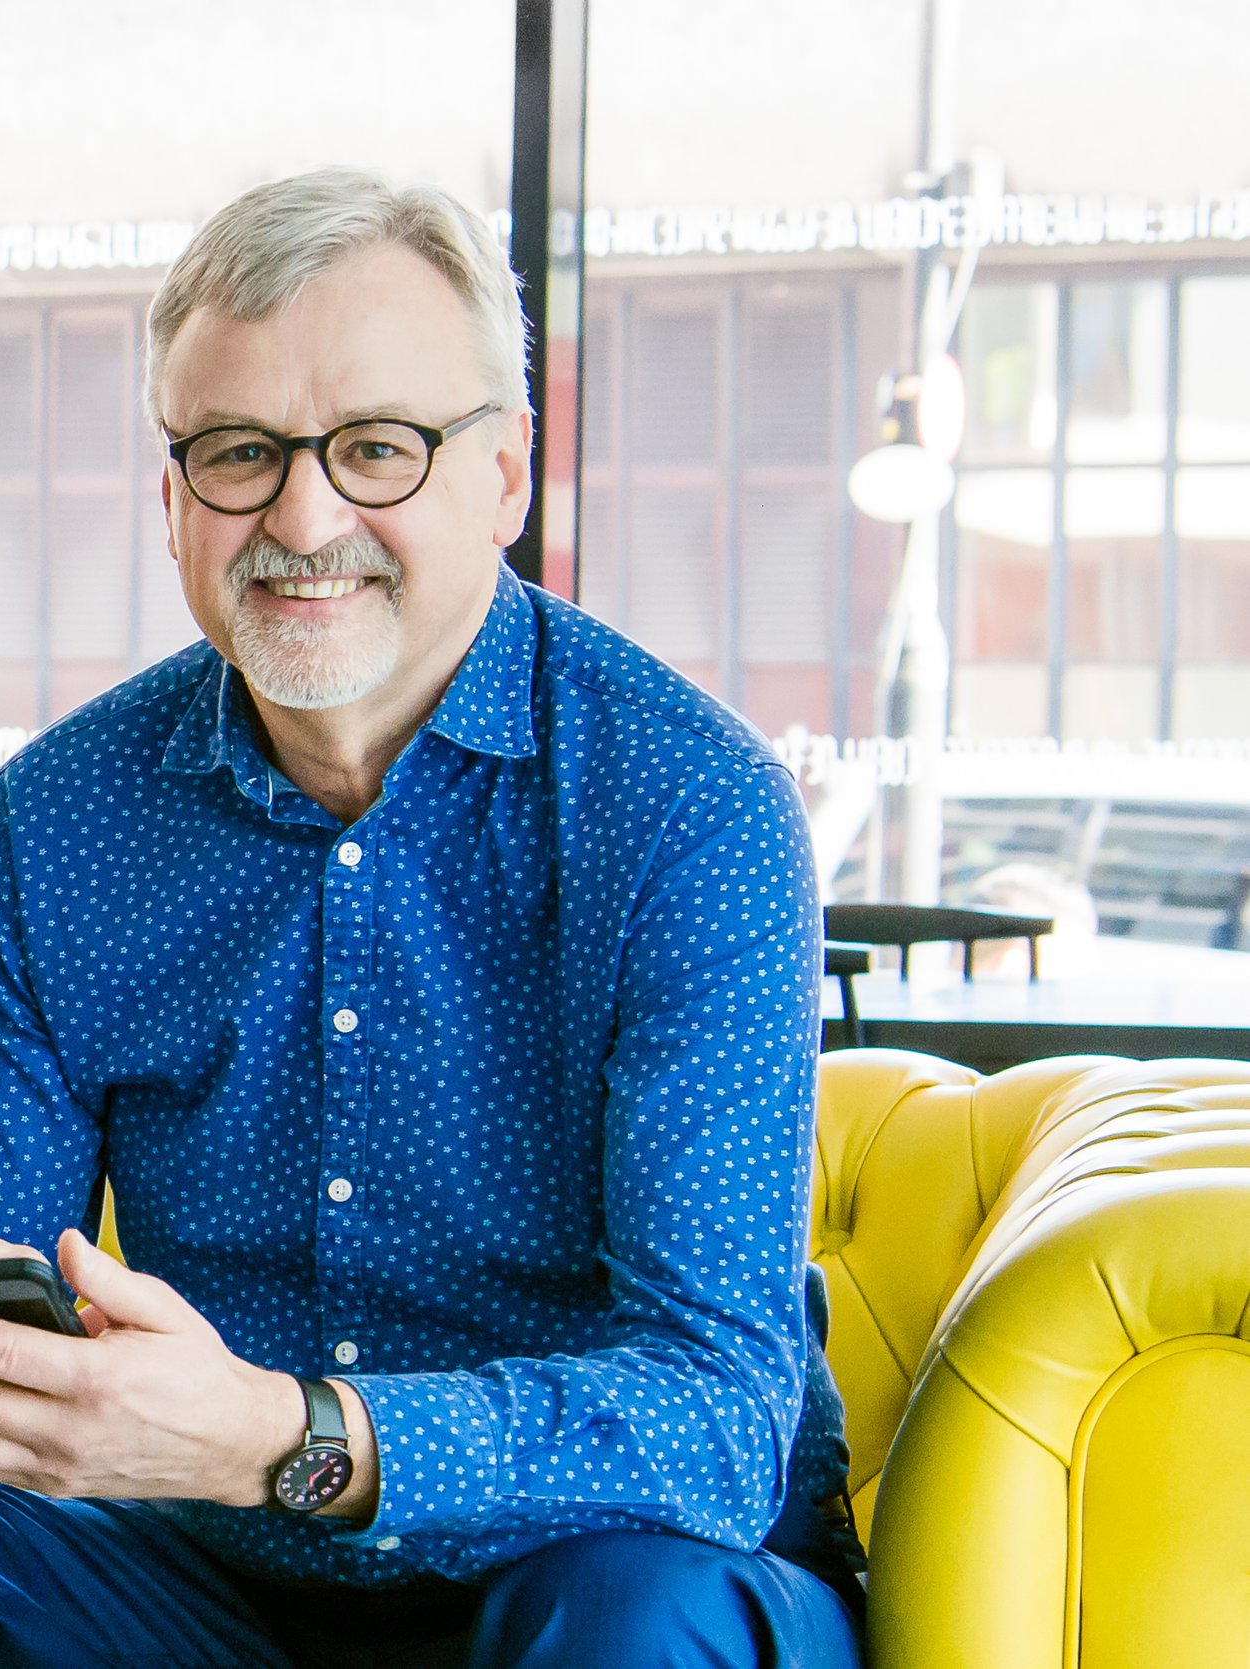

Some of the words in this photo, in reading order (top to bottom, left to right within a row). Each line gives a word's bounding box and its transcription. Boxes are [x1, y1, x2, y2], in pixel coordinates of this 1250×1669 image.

[282, 1482, 291, 1490] 2
[321, 1487, 333, 1496] 10
[310, 1493, 318, 1502] 11
